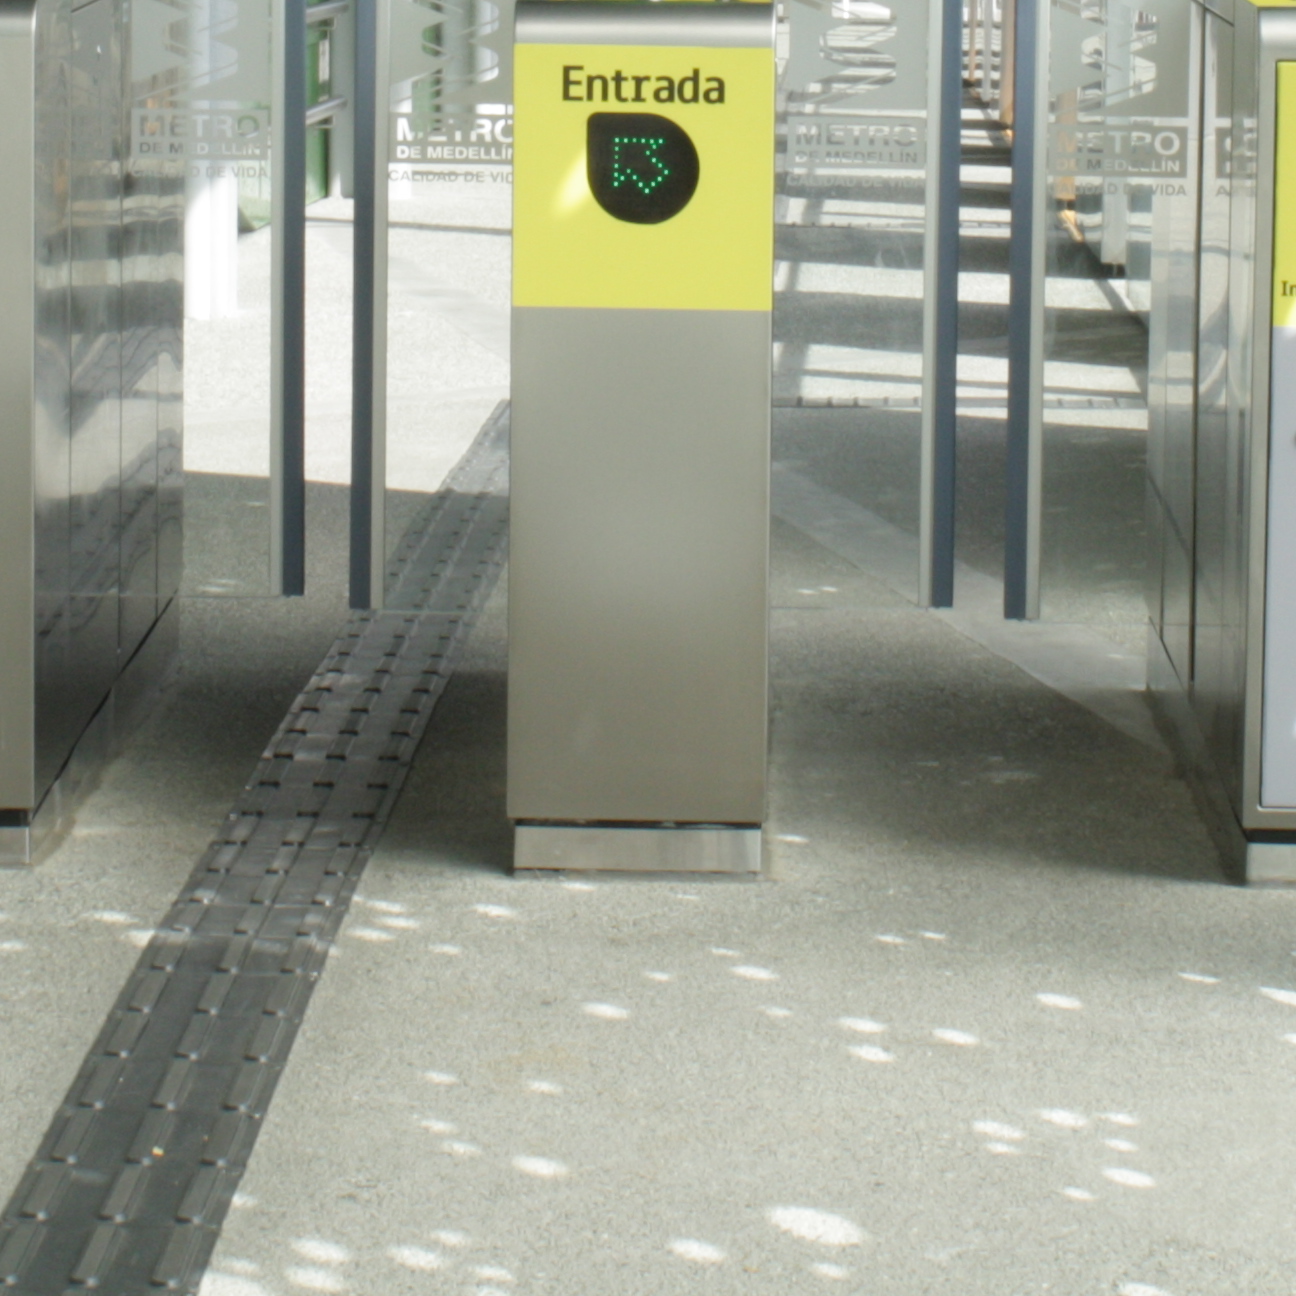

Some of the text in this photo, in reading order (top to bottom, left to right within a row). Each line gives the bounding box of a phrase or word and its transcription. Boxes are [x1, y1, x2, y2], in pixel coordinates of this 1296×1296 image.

[562, 65, 726, 105] Entrada
[139, 114, 260, 138] METRO
[795, 124, 918, 147] METRO
[169, 141, 261, 155] MDLLÍN
[1058, 131, 1180, 156] METRO
[396, 145, 422, 159] DE
[825, 150, 918, 164] MEDELLÍN
[232, 166, 267, 178] VIDA
[388, 170, 458, 182] CALIDAD
[464, 171, 485, 182] DE
[1152, 184, 1186, 196] VIDA
